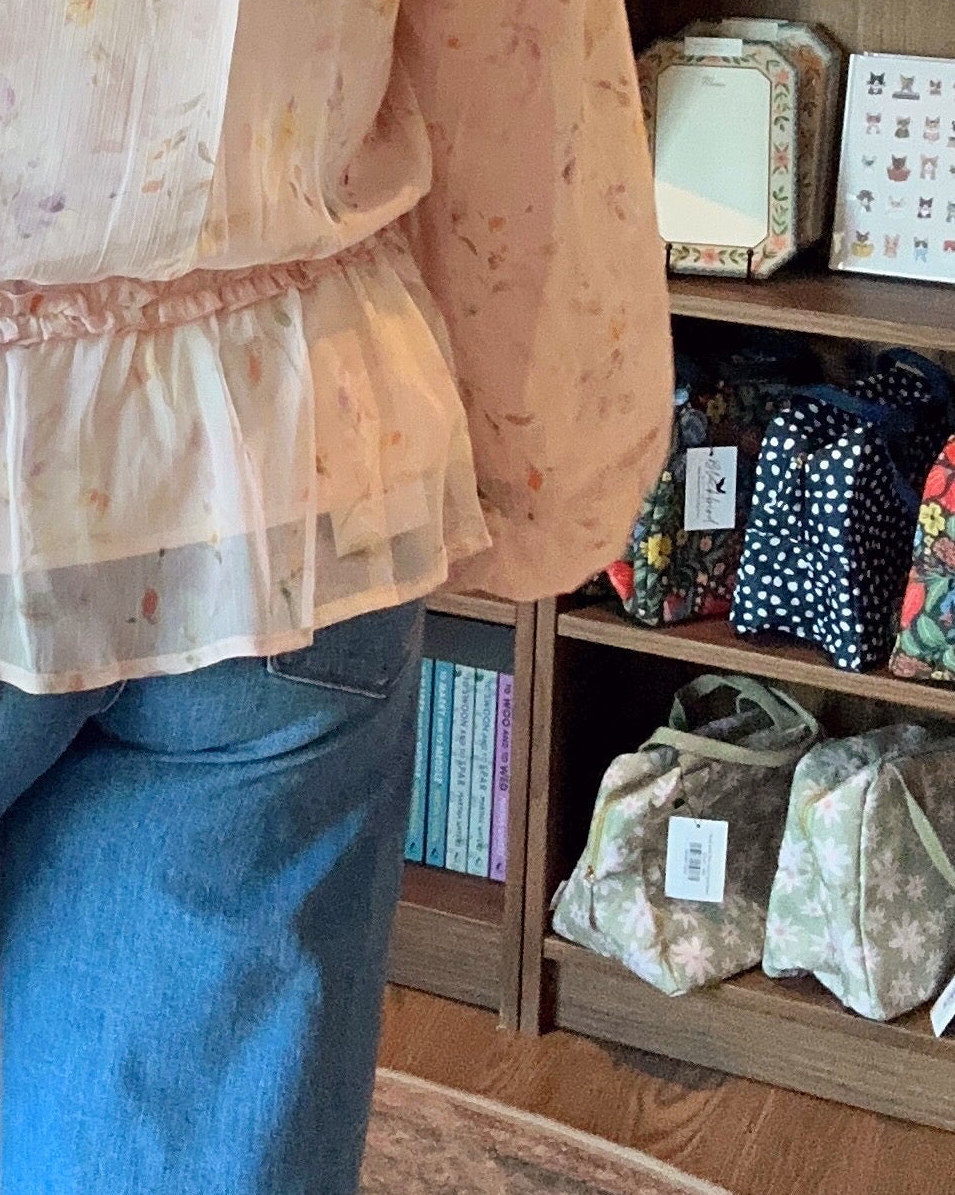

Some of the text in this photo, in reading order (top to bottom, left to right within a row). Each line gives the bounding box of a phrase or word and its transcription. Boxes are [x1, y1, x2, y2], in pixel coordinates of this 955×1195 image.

[459, 689, 469, 727] SWOON
[501, 698, 511, 727] WOO
[456, 760, 466, 786] SPAR
[478, 764, 488, 790] SPAR
[499, 765, 510, 792] WED
